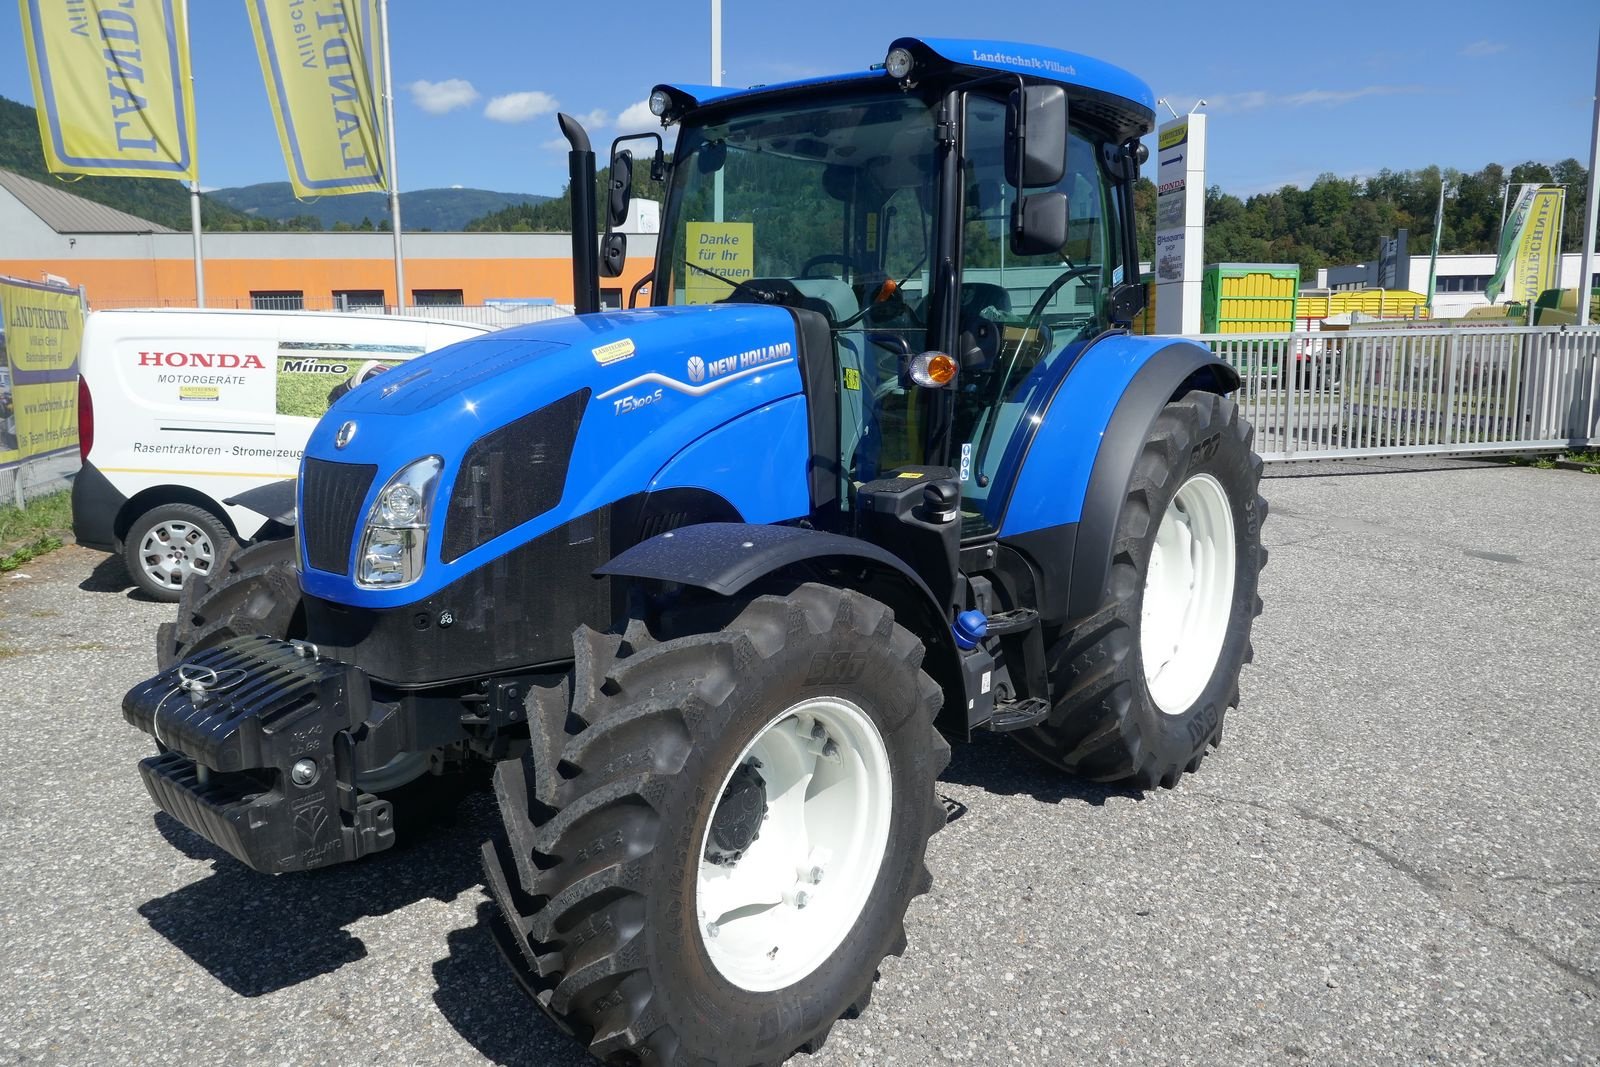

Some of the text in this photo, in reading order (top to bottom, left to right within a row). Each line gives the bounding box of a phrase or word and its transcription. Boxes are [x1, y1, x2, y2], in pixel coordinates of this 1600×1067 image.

[973, 50, 1076, 75] Landtechnik-Villach
[1158, 179, 1185, 193] HONDA
[700, 233, 739, 245] Danke
[698, 249, 739, 260] für Ihr
[11, 306, 69, 330] LANDTECHNIK
[138, 352, 266, 369] HONDA
[282, 359, 348, 374] Miimo
[708, 342, 791, 377] NEW HOLLAND
[158, 374, 246, 385] MOTORGERÄTE
[133, 442, 221, 455] Rasentraktoren
